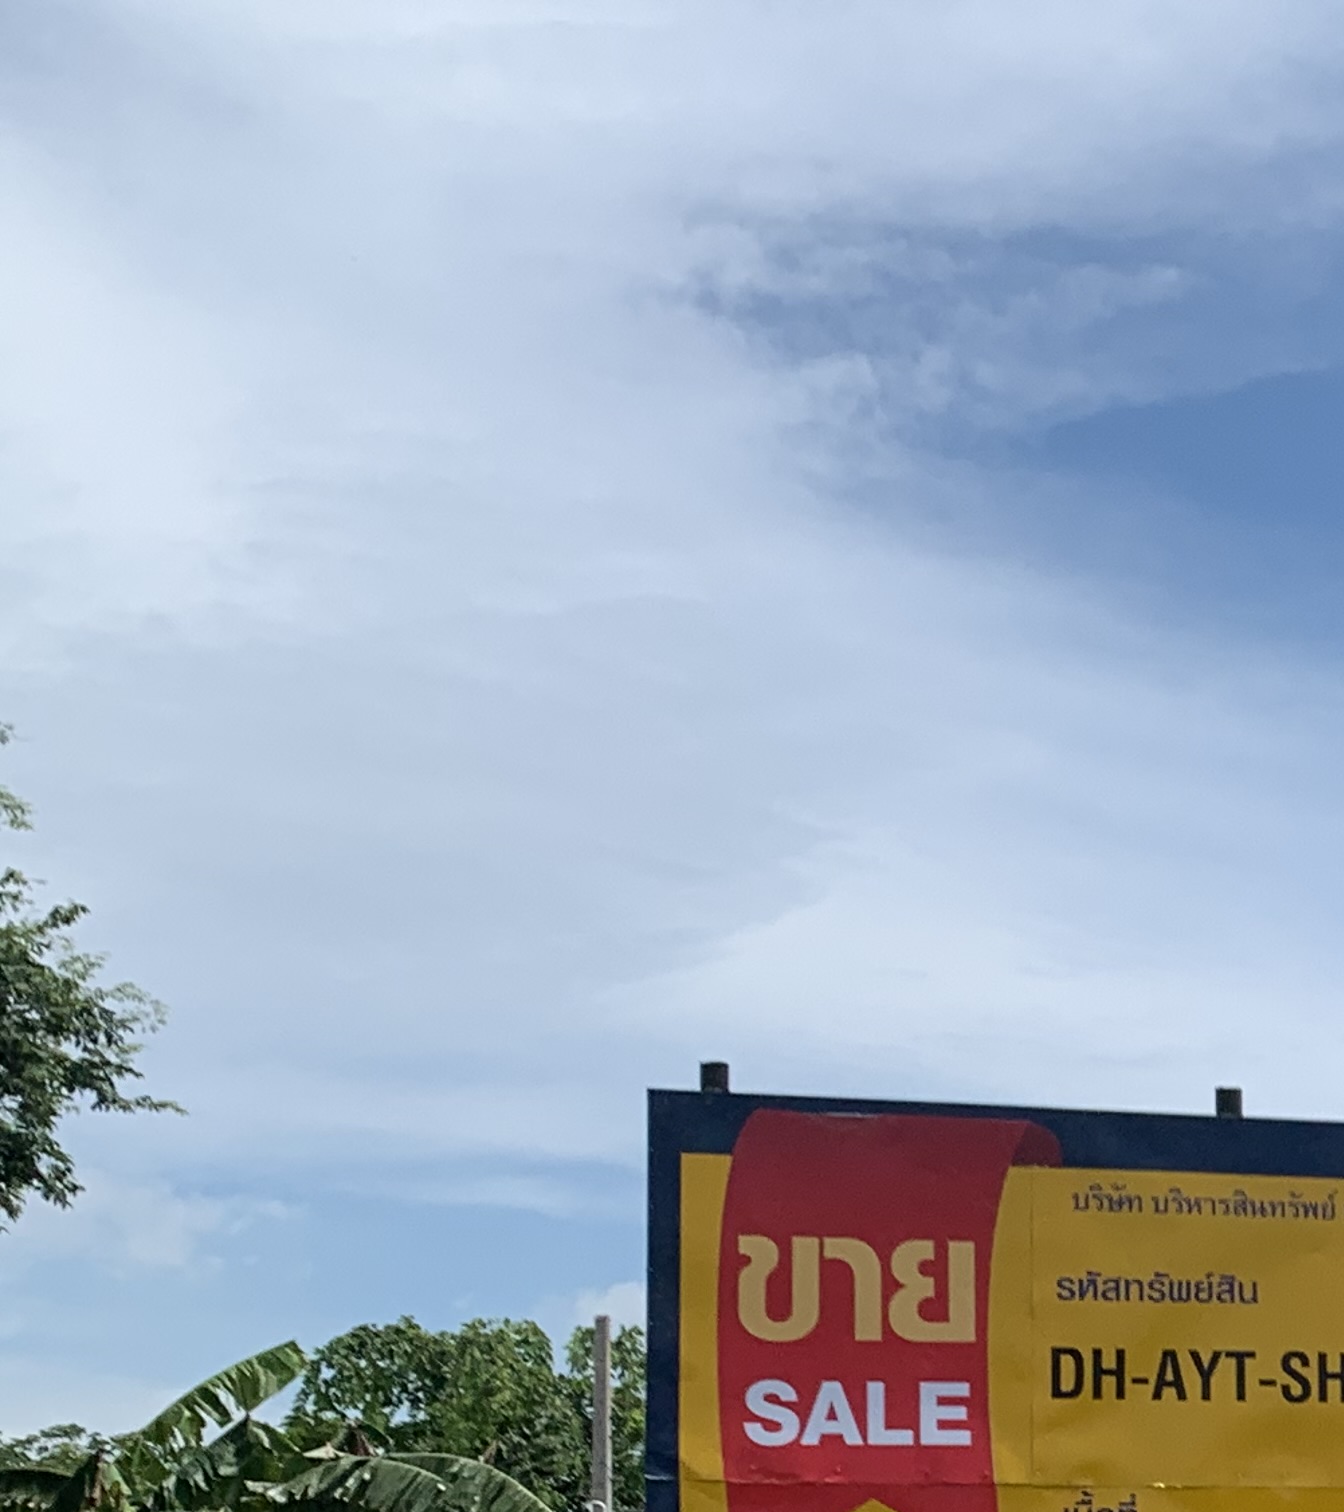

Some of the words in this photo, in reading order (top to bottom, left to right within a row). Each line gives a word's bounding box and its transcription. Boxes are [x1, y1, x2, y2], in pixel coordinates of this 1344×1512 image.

[1072, 1183, 1143, 1213] บริษัท
[1152, 1186, 1337, 1220] บริหารสินทรัพย์
[738, 1234, 977, 1343] ขาย
[1056, 1270, 1260, 1304] รหัสทรัพย์สิน
[743, 1378, 973, 1447] SALE
